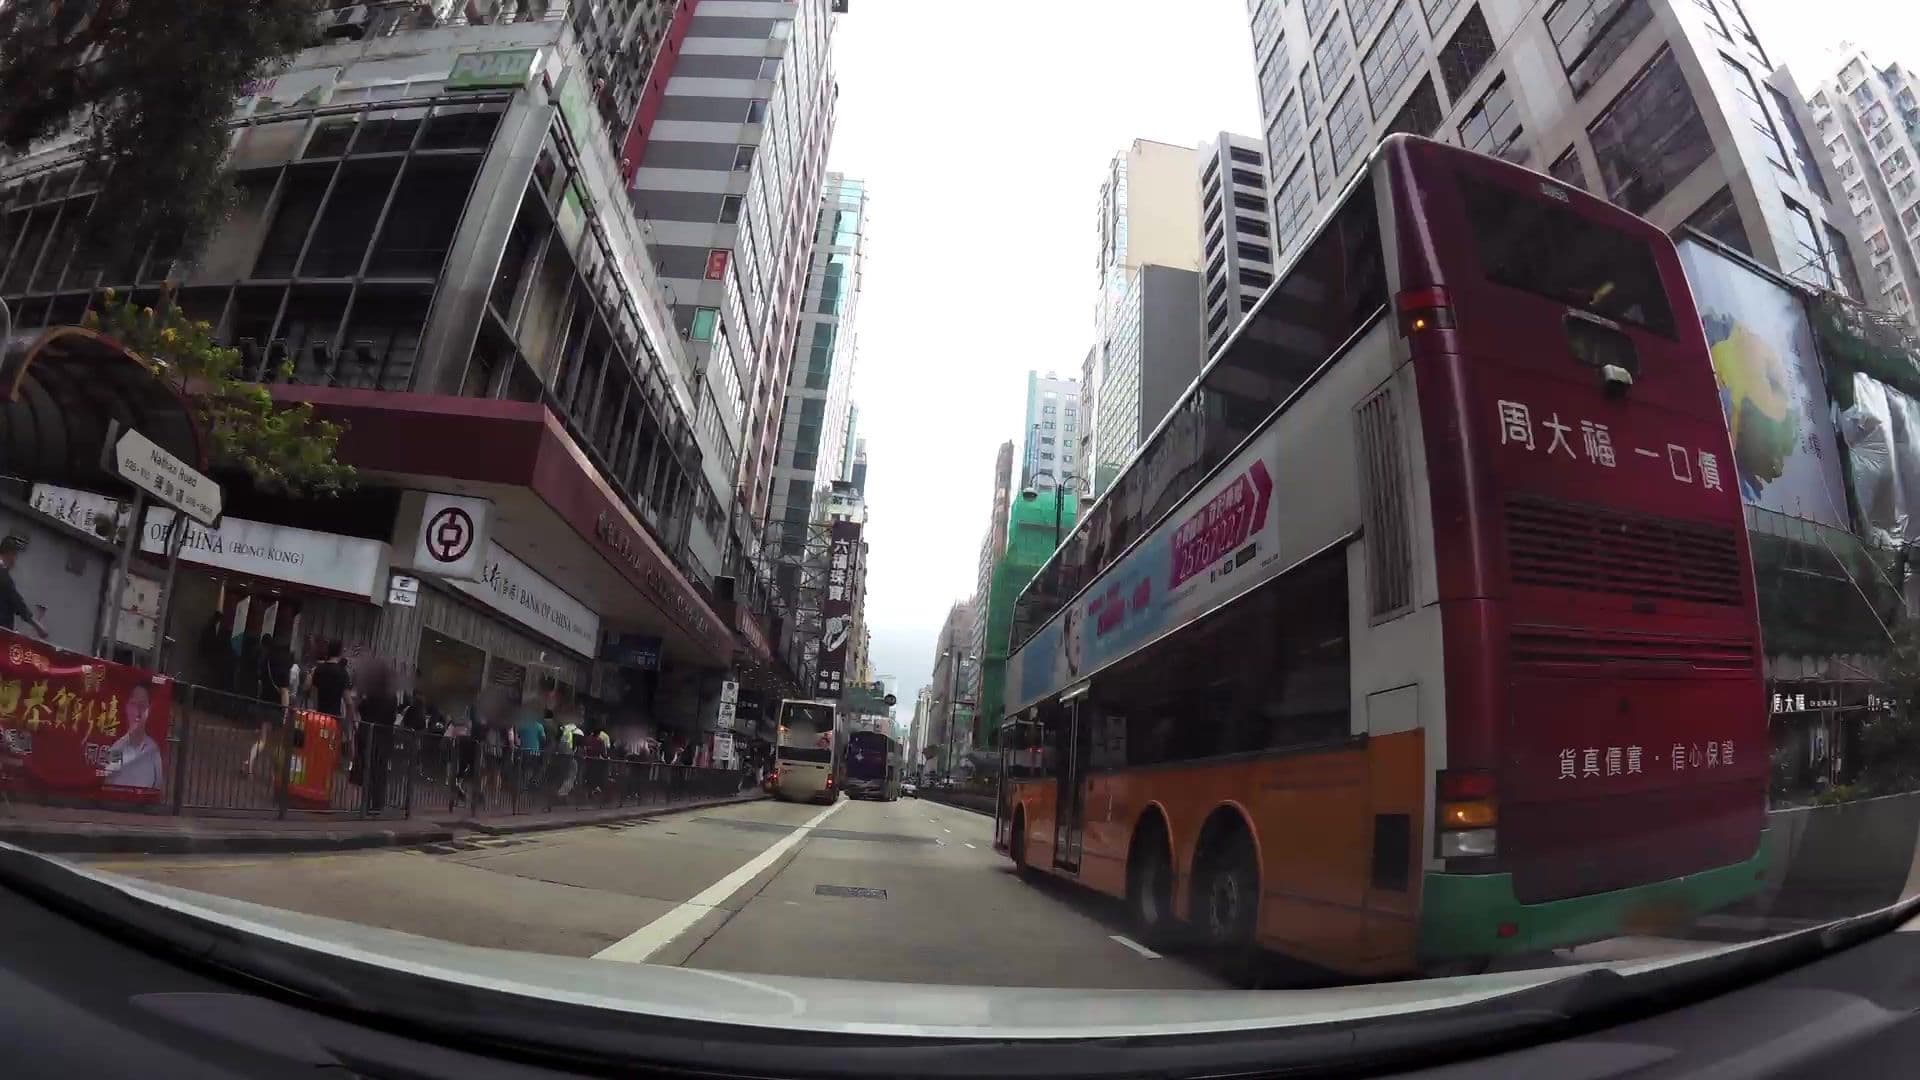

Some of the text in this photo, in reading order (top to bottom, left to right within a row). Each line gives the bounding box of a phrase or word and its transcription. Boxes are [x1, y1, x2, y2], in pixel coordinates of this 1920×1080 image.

[1497, 399, 1723, 493] 周大福 一口價
[151, 449, 178, 475] Nathan
[178, 466, 197, 488] Road
[520, 589, 540, 614] BANK
[1773, 693, 1805, 713] 周大福
